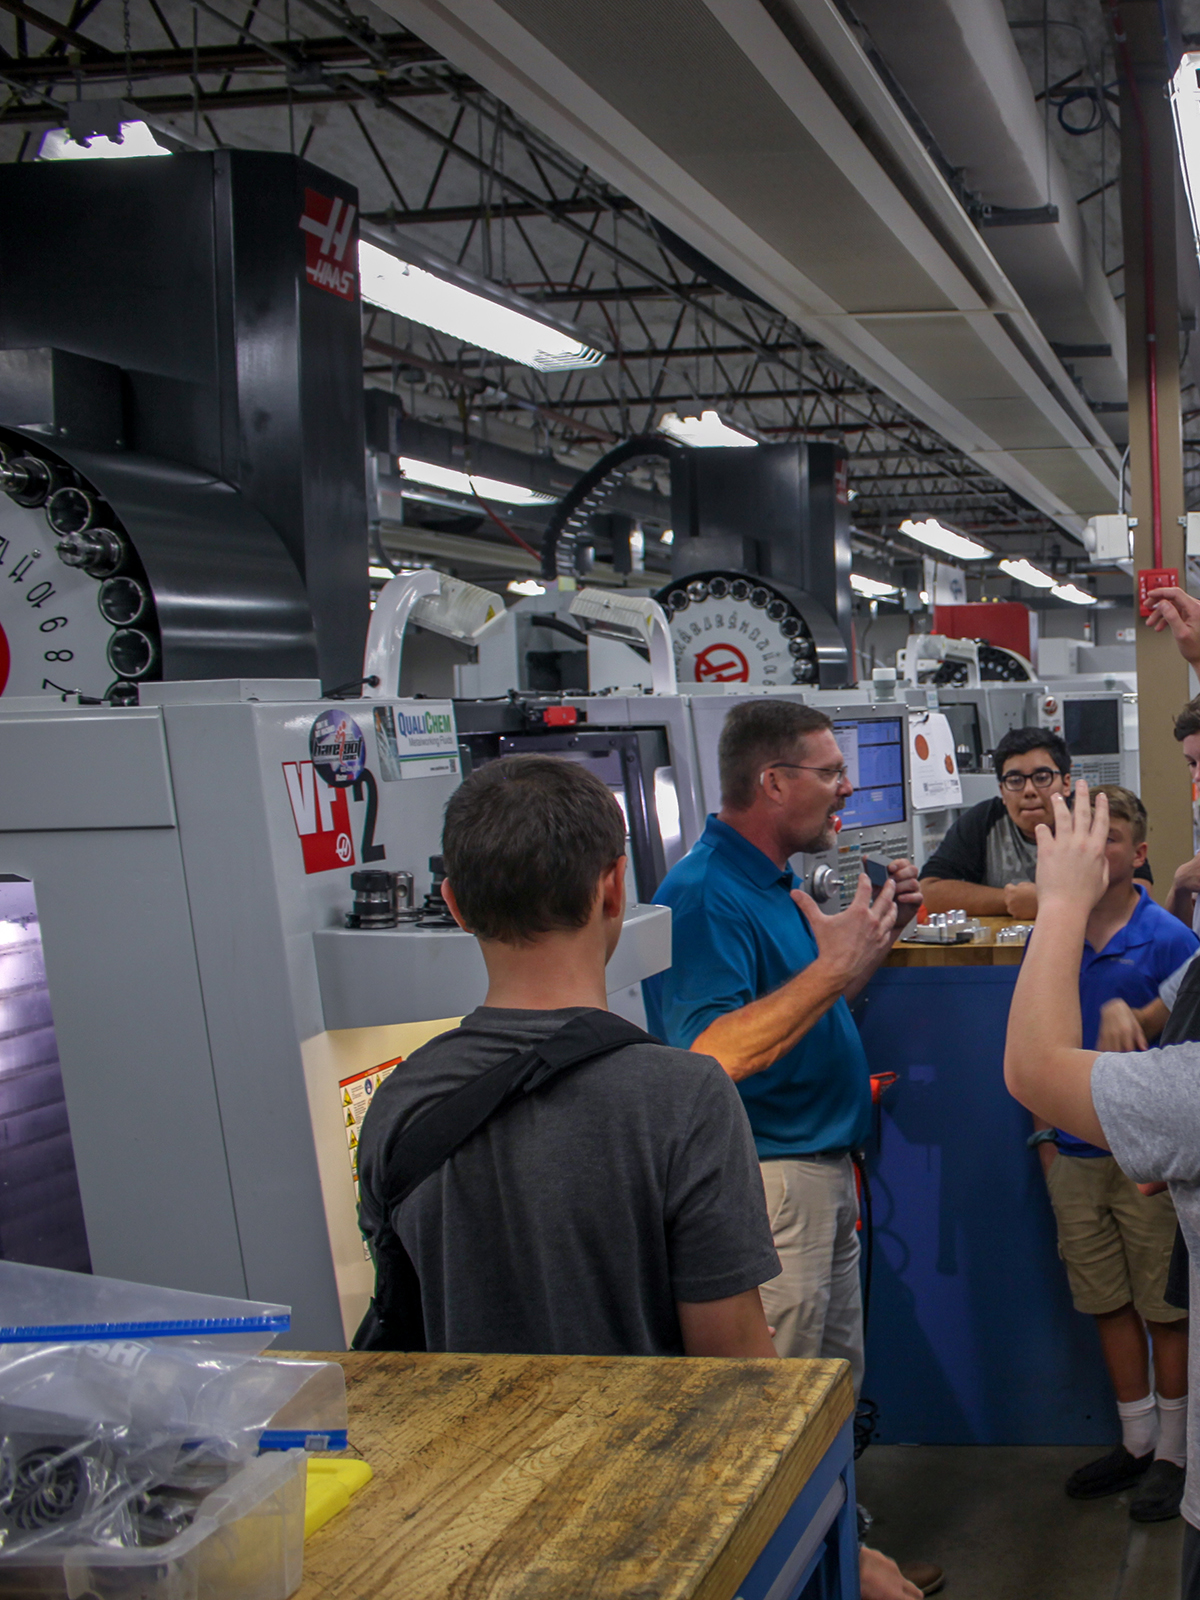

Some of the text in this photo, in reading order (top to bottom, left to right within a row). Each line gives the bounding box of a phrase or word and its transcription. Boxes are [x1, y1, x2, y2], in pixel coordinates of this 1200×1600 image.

[306, 259, 355, 295] HAAS
[44, 649, 74, 662] 8
[353, 767, 386, 864] 2
